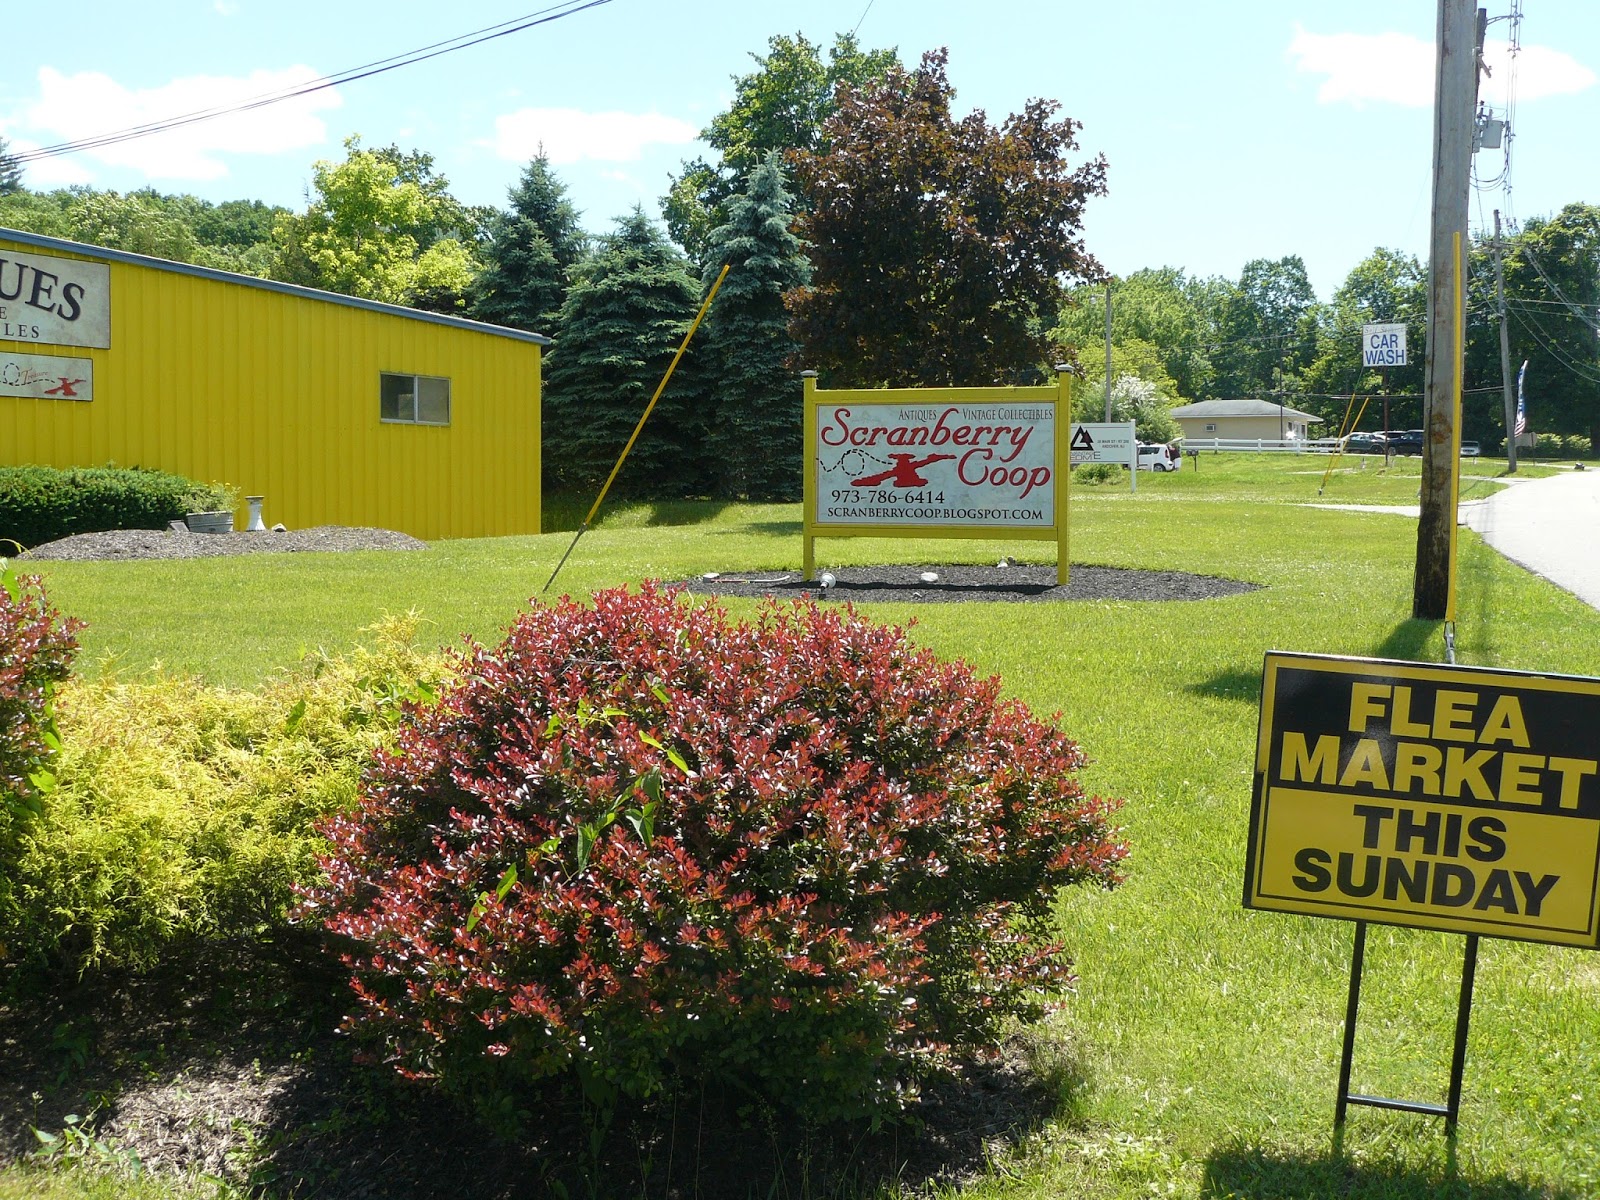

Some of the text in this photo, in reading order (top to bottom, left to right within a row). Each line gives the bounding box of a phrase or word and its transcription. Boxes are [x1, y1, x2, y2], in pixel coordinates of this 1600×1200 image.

[4, 323, 40, 338] LES
[1370, 334, 1398, 349] CAR
[1365, 349, 1405, 364] WASH
[899, 408, 1053, 420] ANTIQUES VINTAGE COLLECTIBLES
[821, 408, 1034, 463] Scranberry
[958, 448, 1051, 500] Coop
[827, 507, 1043, 520] SCRANBERRYCOOP.BLOGSPOT.COM
[831, 490, 945, 504] 973-786-6414
[1348, 682, 1531, 748] FLEA
[1279, 731, 1598, 810] MARKET
[1353, 804, 1507, 862] THIS
[1291, 847, 1560, 917] SUNDAY
